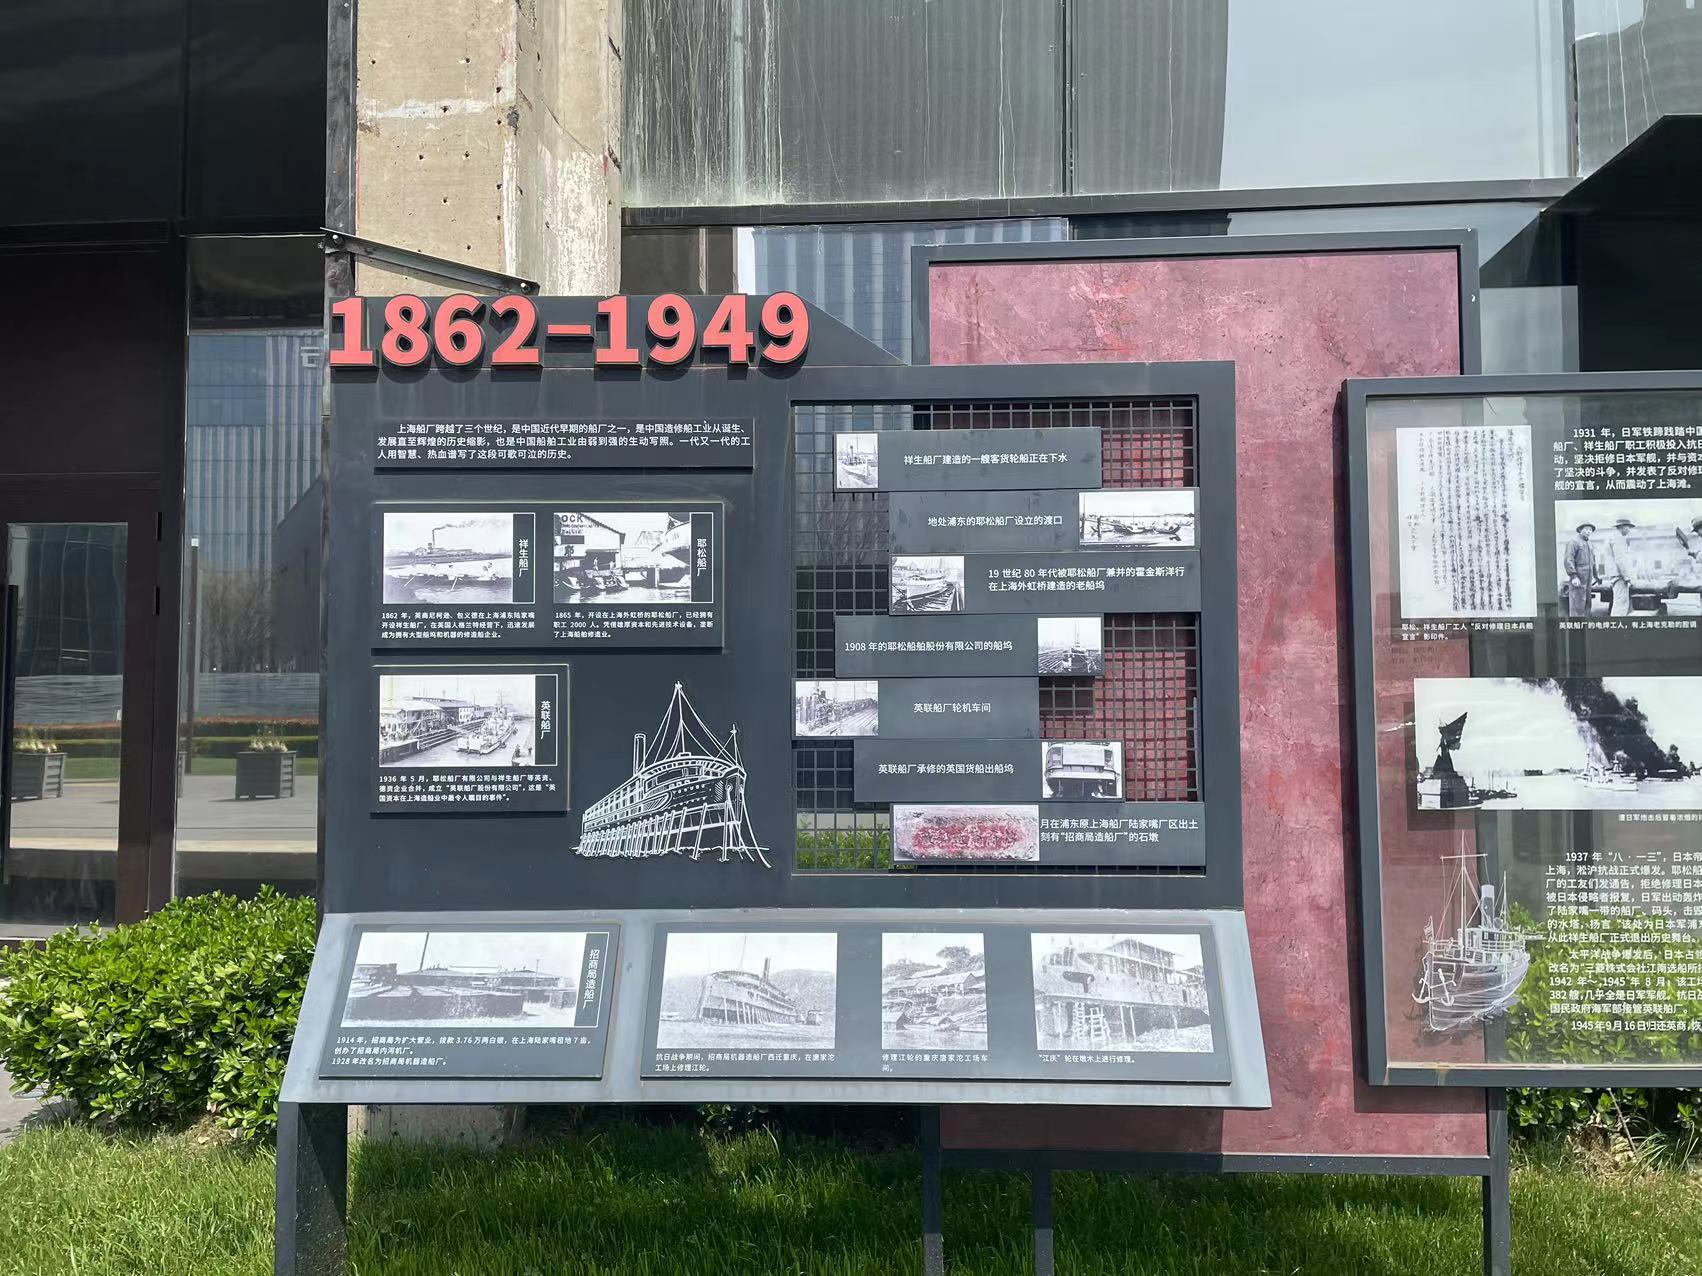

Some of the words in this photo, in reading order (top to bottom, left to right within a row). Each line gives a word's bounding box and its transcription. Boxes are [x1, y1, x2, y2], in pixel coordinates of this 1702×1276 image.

[397, 424, 746, 434] 上海船厂跨越了三个世纪，是中国近代早期的船厂之一，是中国造修船工业从诞生、
[1573, 428, 1596, 438] 1931
[377, 436, 750, 448] 发展直至辉煌的历史缩影，也是中国船舶工业由弱到强的生动写照。一代又一代的工
[377, 450, 572, 460] 人用智慧、热血谱写了这段可歌可泣的历史。
[904, 453, 1068, 465] 祥生船厂建造的一艘客货轮船正在下水
[1554, 479, 1692, 491] 舰的宣言，从而震动了上海滩。
[928, 516, 1063, 526] 地处浦东的耶松船厂设立的渡口
[518, 538, 529, 578] 祥生船厂
[696, 538, 707, 576] 耶松船厂
[988, 569, 1000, 578] 19
[1002, 568, 1022, 578] 世纪
[1024, 569, 1035, 578] 80
[1038, 566, 1184, 578] 年代被耶松船厂兼并的霍金斯洋行
[988, 580, 1105, 592] 在上海外虹桥建造的老船坞
[844, 642, 866, 651] 1908
[868, 640, 1013, 651] 年的耶松船舶股份有限公司的船坞
[914, 703, 992, 714] 英联船厂轮机车间
[540, 700, 552, 740] 英联船厂
[878, 764, 1014, 774] 英联船厂承修的英国货船出船坞
[1040, 818, 1199, 829] 月在浦东原上海船厂陆家嘴厂区出土
[1040, 832, 1160, 842] 刻有“招商局造船厂”的石墩
[1565, 852, 1588, 862] 1937
[1546, 865, 1702, 876] 上海，淞沪抗战正式爆发。耶松船
[1546, 878, 1702, 889] 厂的工友们发通告，拒绝修理日本
[1546, 892, 1702, 903] 被日本侵略者报复，日军出动轰炸
[582, 949, 600, 1010] 招商局造船厂
[1550, 976, 1572, 986] 1942
[1630, 977, 1640, 987] 年
[1646, 977, 1651, 986] 8
[1550, 990, 1566, 1000] 382
